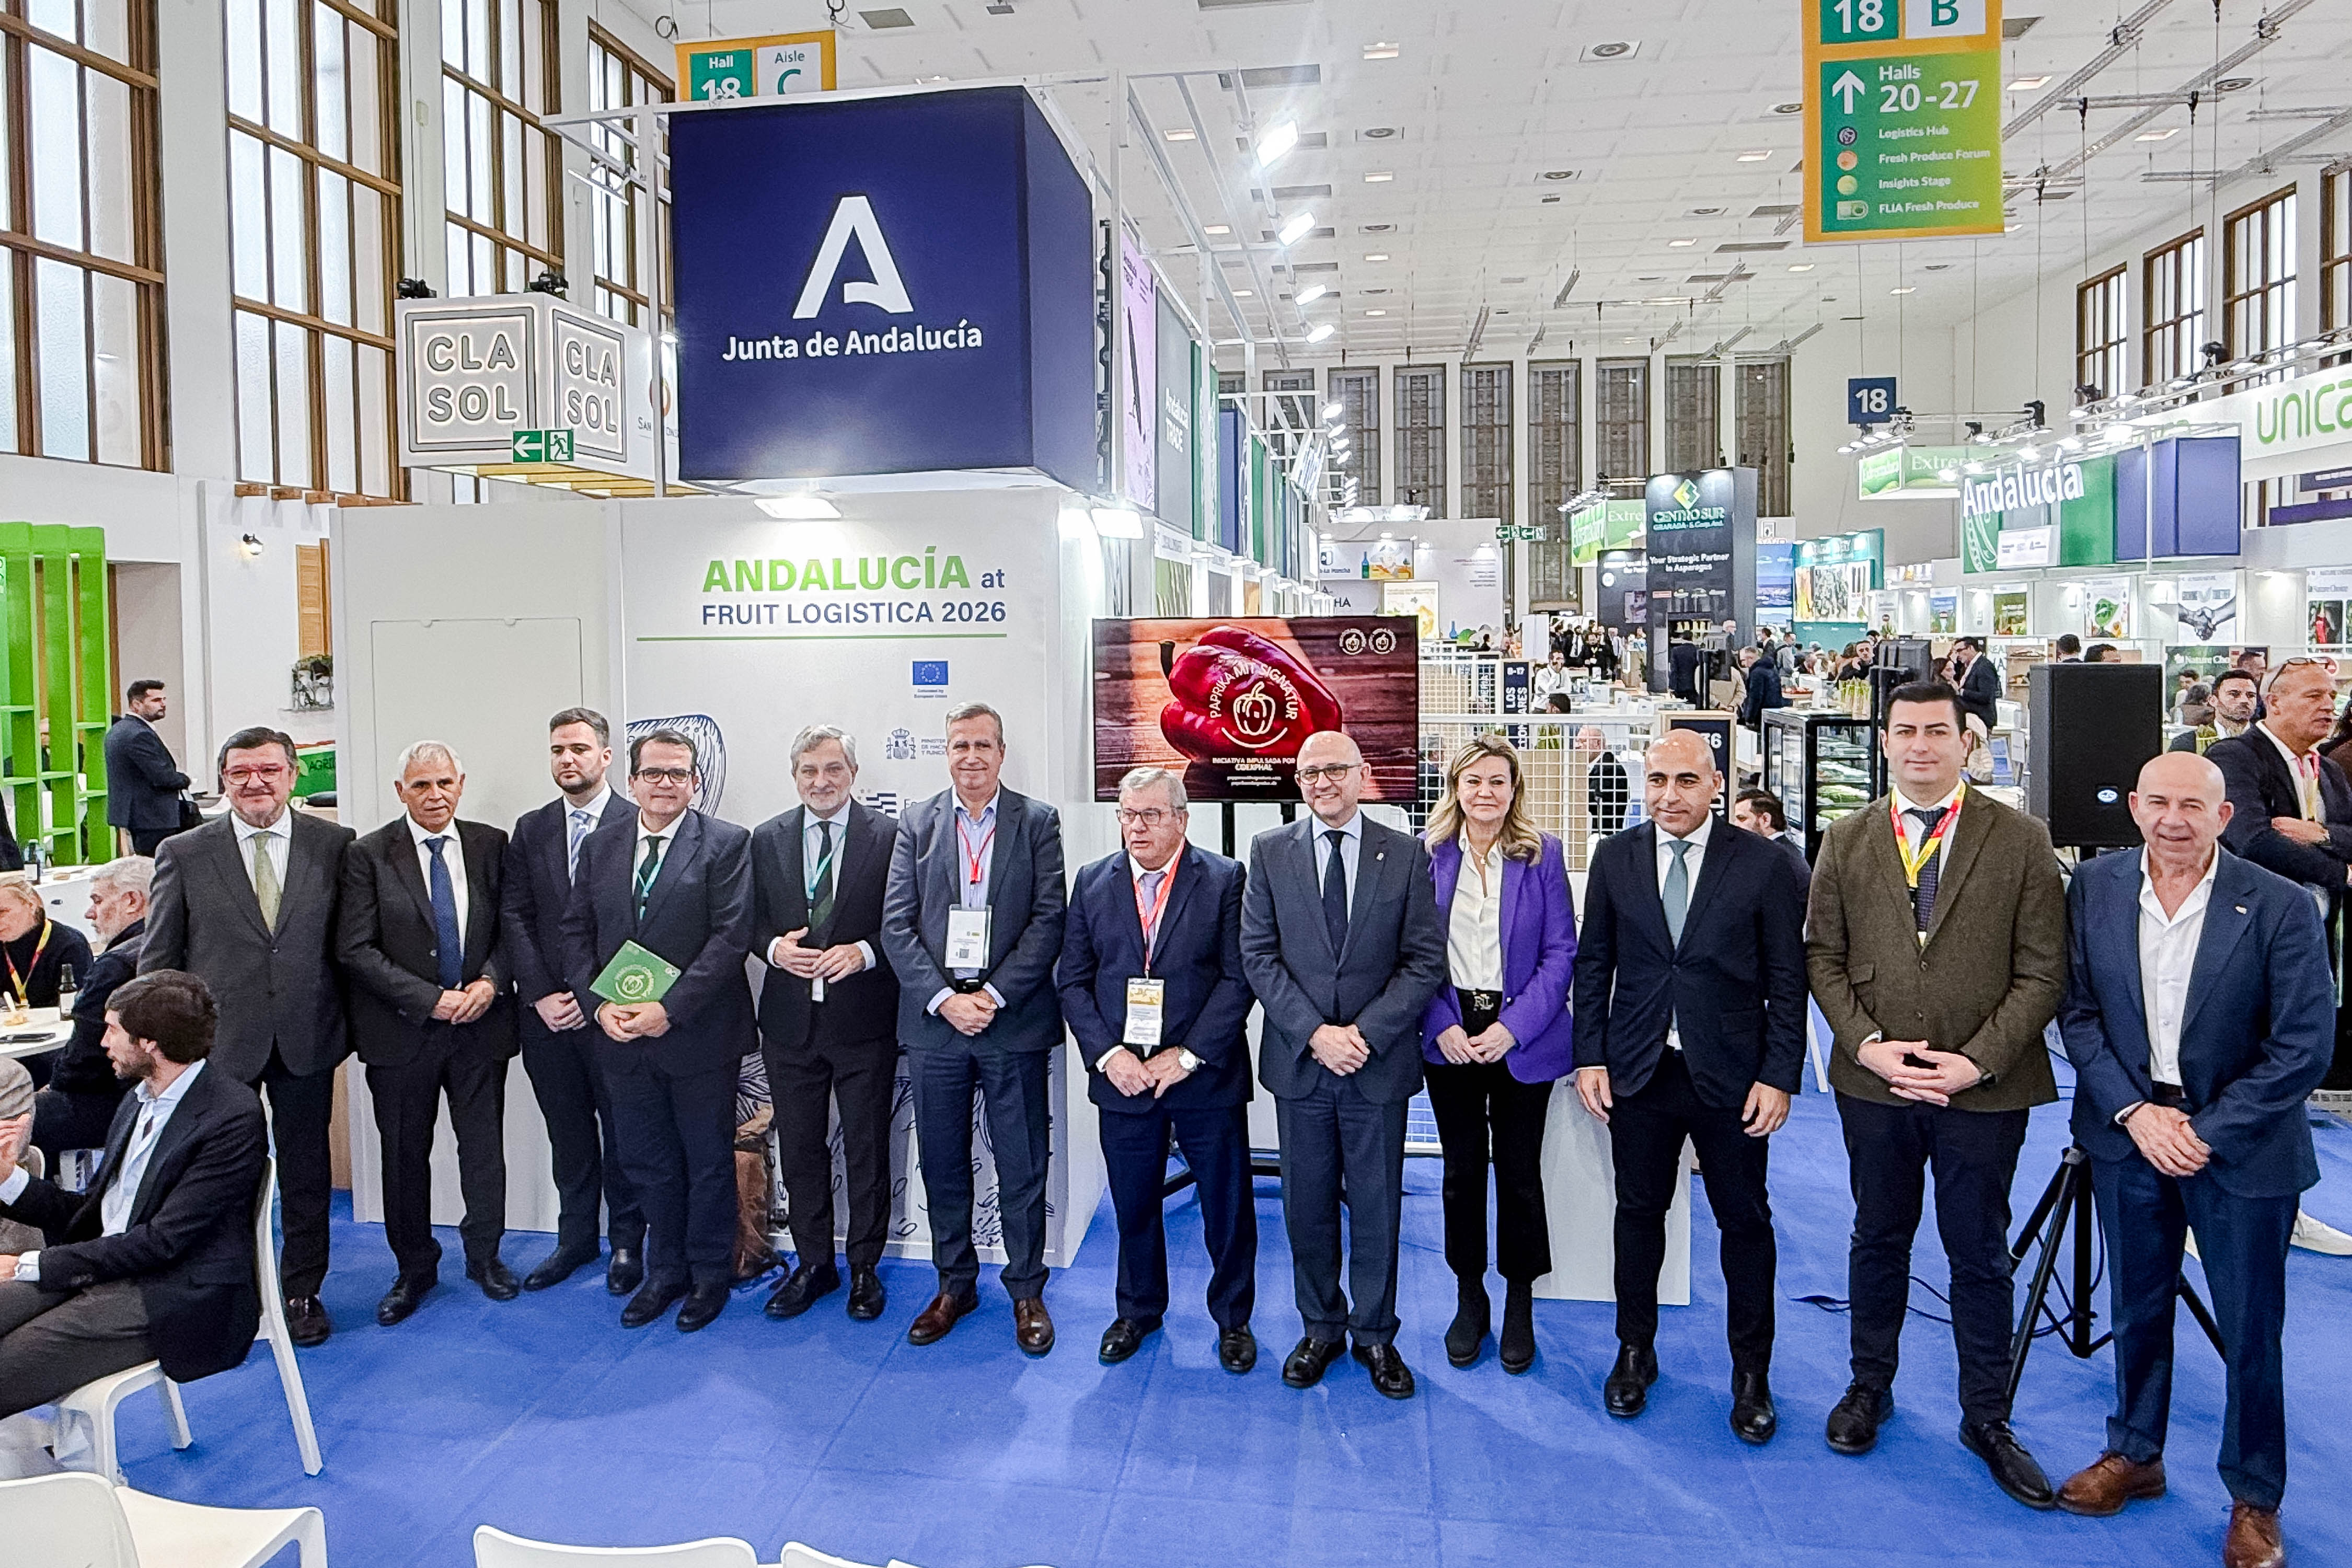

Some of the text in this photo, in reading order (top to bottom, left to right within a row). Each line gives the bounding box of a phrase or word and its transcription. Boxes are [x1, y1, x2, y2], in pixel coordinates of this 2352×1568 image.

[1834, 0, 1884, 33] 18
[1931, 0, 1959, 27] B
[708, 55, 734, 69] Hall
[775, 51, 805, 64] Aisle
[1878, 64, 1921, 81] Halls
[701, 76, 741, 101] 18
[1878, 125, 1949, 140] Logistics Hub
[1879, 149, 1990, 164] Fresh Produce Forum
[1879, 176, 1951, 189] Insights Stage
[1905, 201, 1934, 212] Fresh
[1936, 200, 1979, 210] Produce
[722, 319, 983, 361] Junta de Andalucía
[427, 333, 515, 372] CLA
[567, 340, 616, 387] CLA
[428, 385, 517, 422] SOL
[567, 389, 618, 433] SOL
[1855, 388, 1888, 413] 18
[1963, 446, 2085, 518] Andalucía
[1701, 506, 1725, 520] SUR
[702, 546, 1006, 593] ANDALUCÍA at
[1650, 553, 1730, 564] Your Strategic Partner
[1674, 563, 1713, 573] Asparagus
[702, 602, 1006, 625] FRUIT LOGISTICA 2026
[1209, 672, 1236, 718] PAPRIKA
[1260, 664, 1299, 720] SIGNATUR
[1506, 687, 1516, 708] LOS
